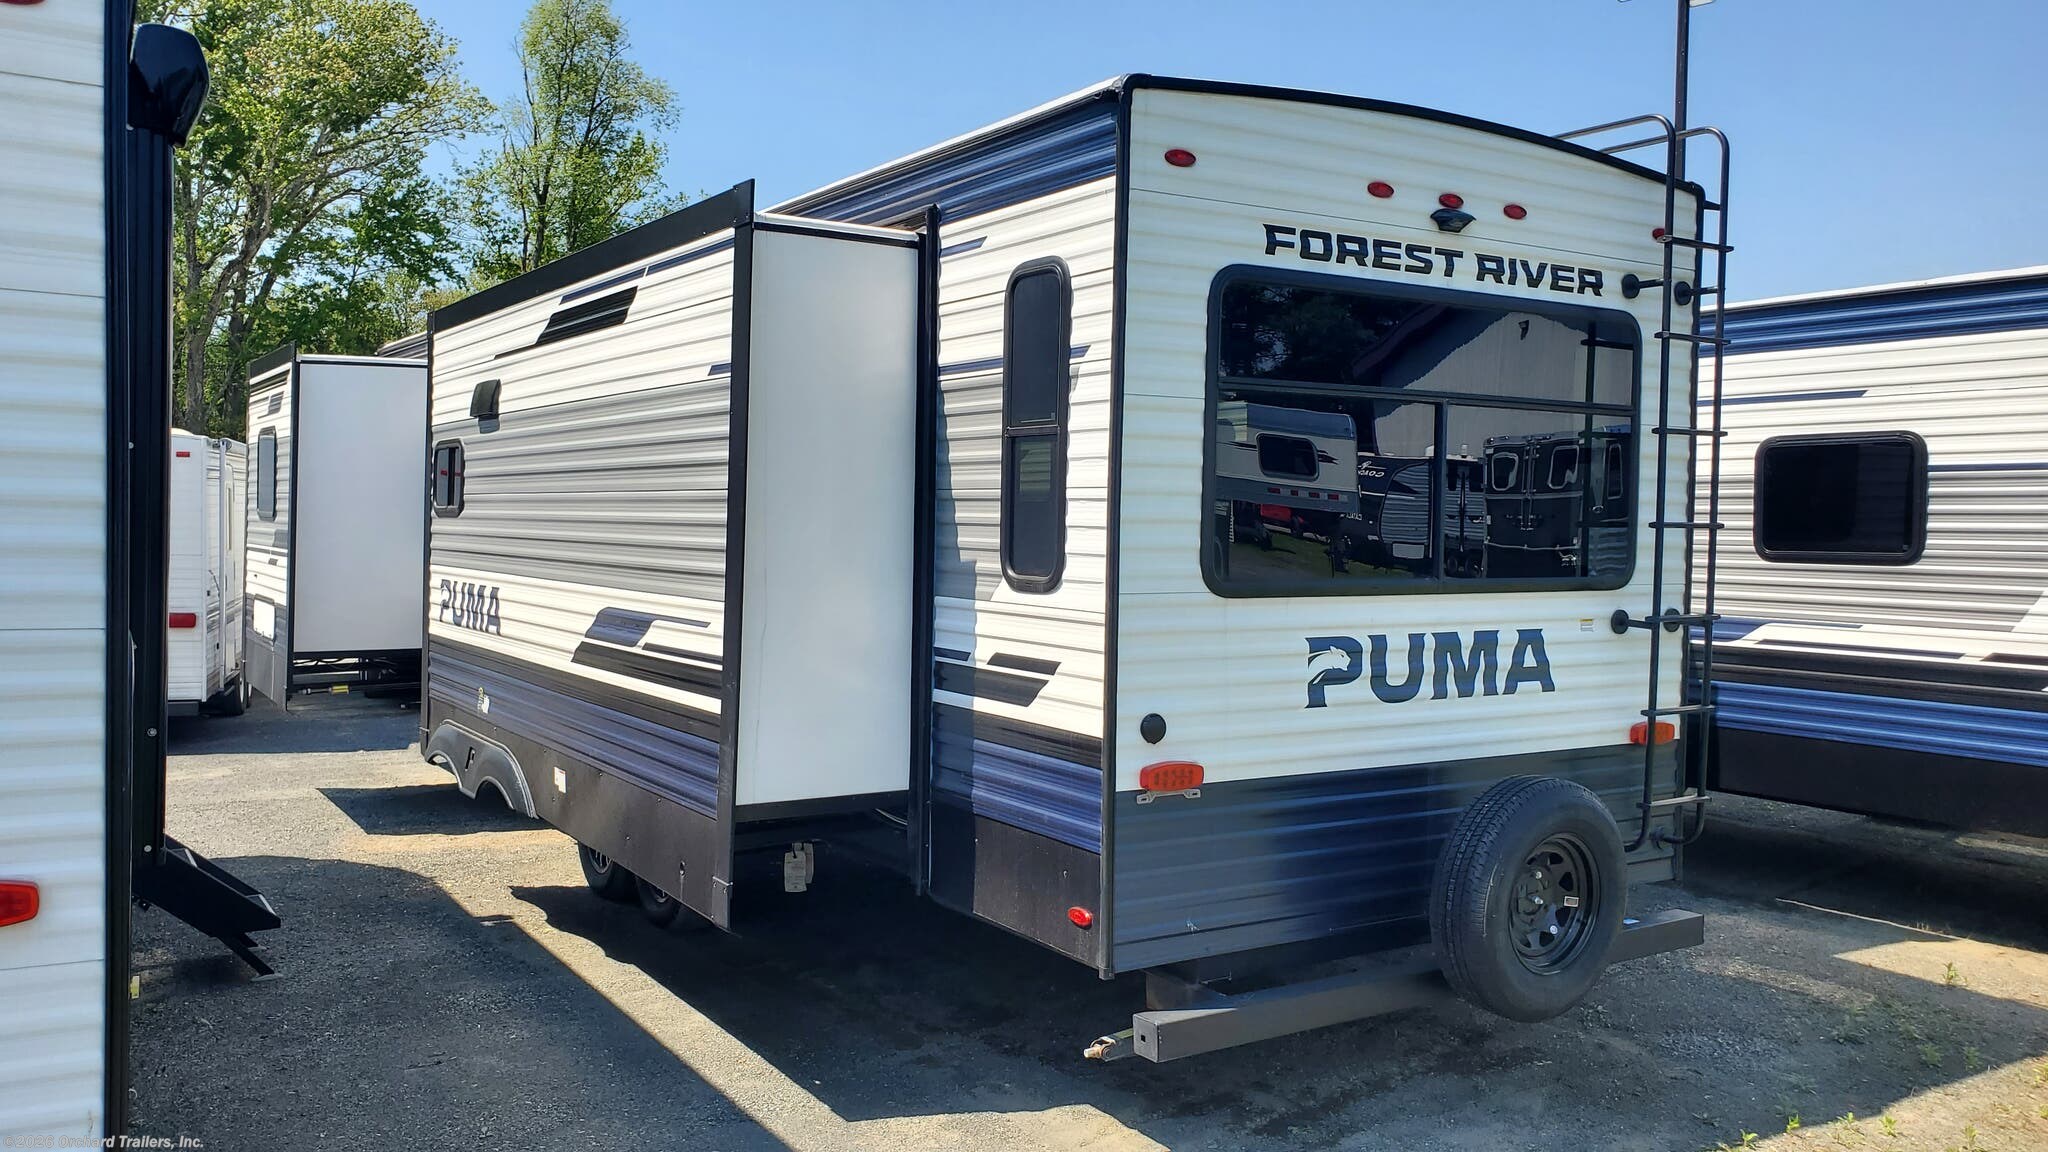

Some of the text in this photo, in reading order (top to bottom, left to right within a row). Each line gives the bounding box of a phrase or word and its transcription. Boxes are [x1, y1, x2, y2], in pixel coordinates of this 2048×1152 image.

[1262, 223, 1604, 297] FOREST RIVER
[439, 578, 502, 636] PUMA
[1304, 628, 1556, 709] PUMA
